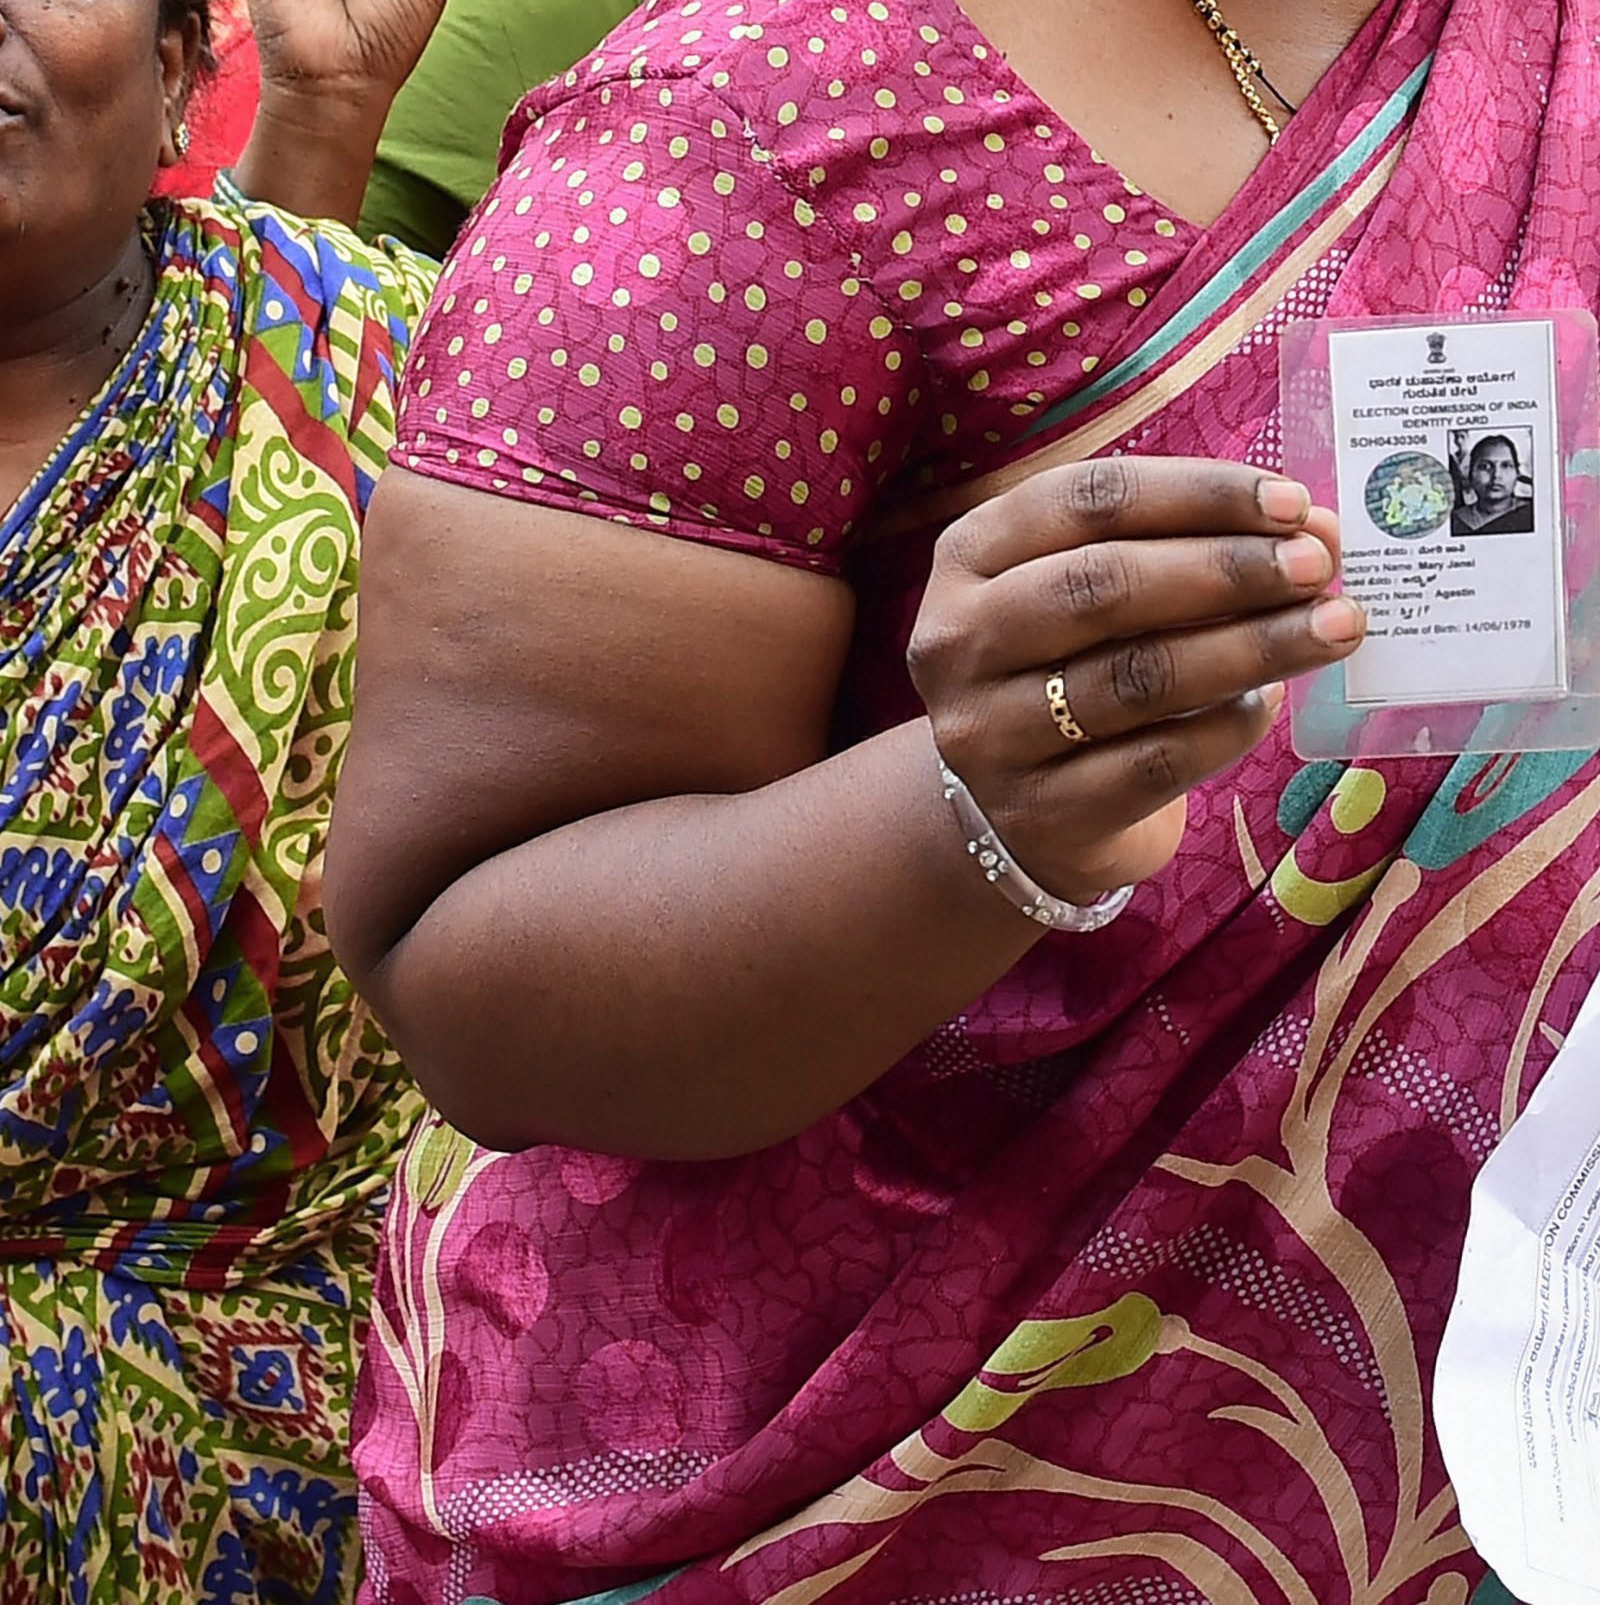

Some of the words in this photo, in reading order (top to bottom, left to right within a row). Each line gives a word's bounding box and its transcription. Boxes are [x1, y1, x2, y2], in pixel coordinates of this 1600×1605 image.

[1353, 407, 1408, 418] ELECTION
[1412, 403, 1485, 415] COMMISSION
[1489, 402, 1503, 411] OF
[1508, 400, 1538, 410] INDIA
[1402, 418, 1452, 428] IDENTITY
[1456, 416, 1489, 426] CARD
[1344, 563, 1379, 573] lector's
[1383, 562, 1412, 571] Name
[1418, 561, 1444, 571] Mary
[1393, 591, 1423, 599] Name
[1372, 608, 1390, 616] Sex
[1421, 626, 1431, 634] of
[1466, 620, 1531, 632] 14/06/1978
